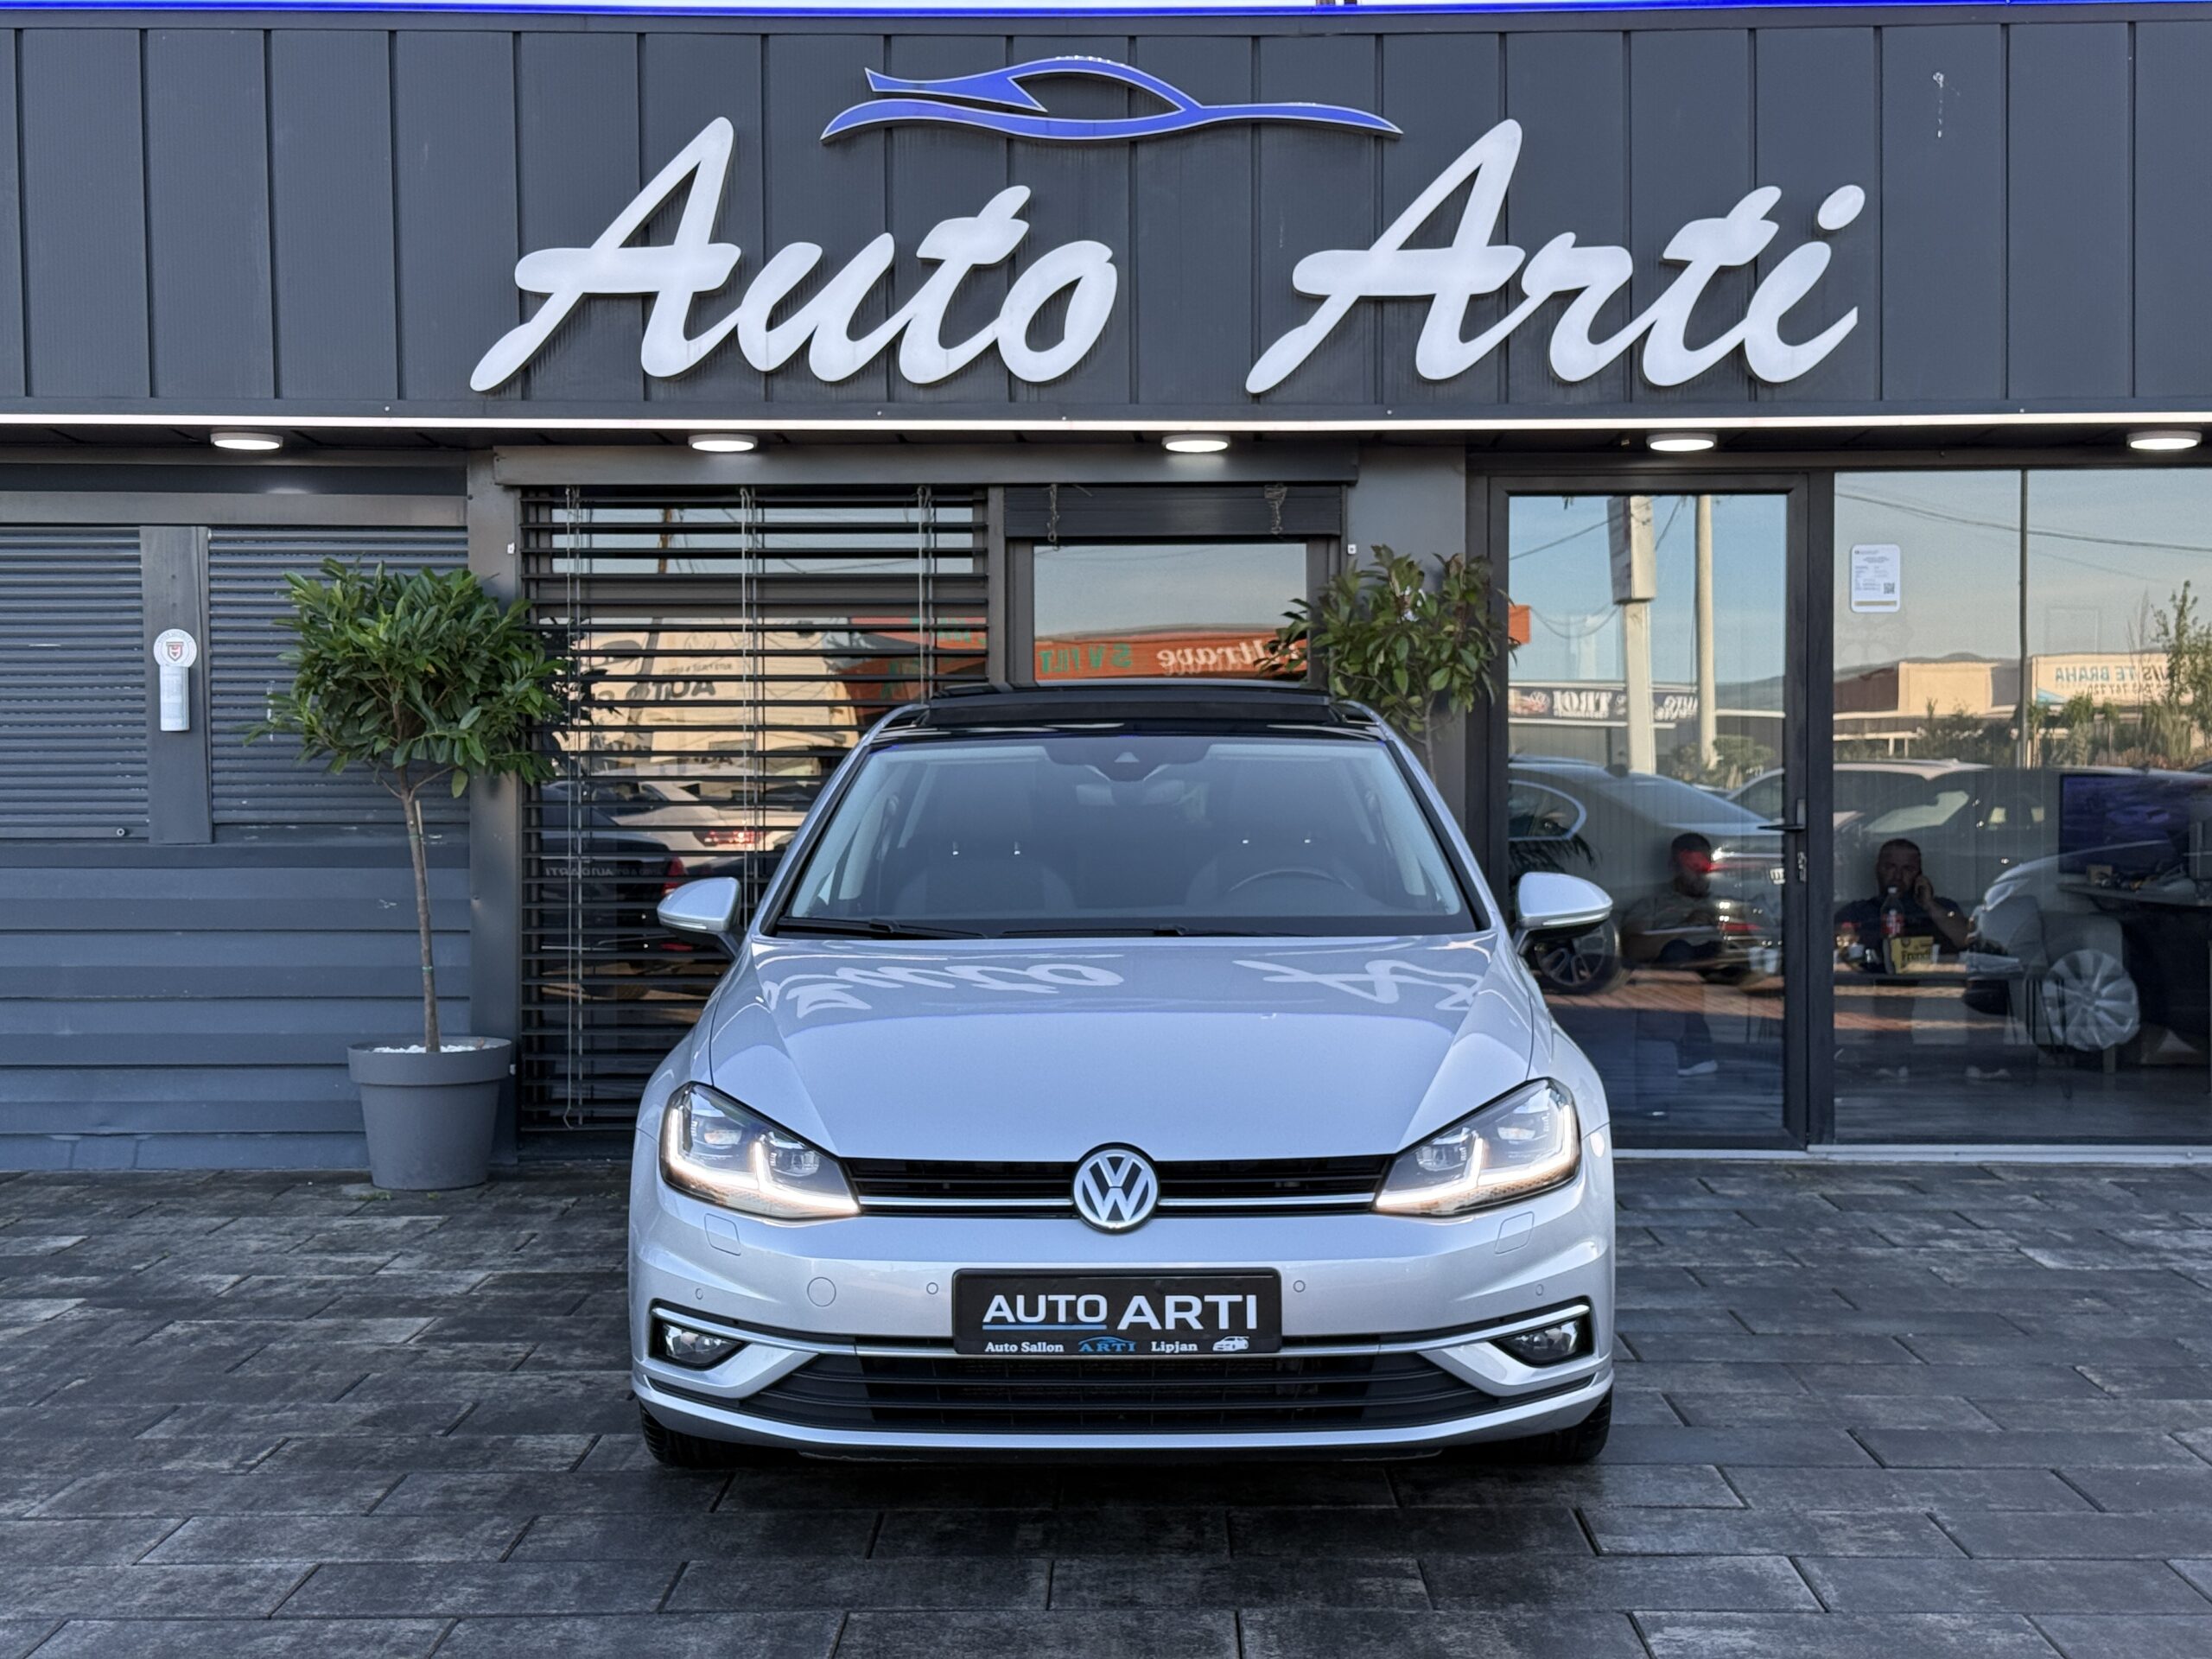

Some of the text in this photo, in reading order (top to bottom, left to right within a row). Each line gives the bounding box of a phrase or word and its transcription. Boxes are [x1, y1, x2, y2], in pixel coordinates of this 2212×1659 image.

[470, 117, 1865, 393] Auto Arti
[982, 1294, 1257, 1331] AUTO ARTI
[985, 1341, 1198, 1354] Auto Sallon ARTI Lipjan
